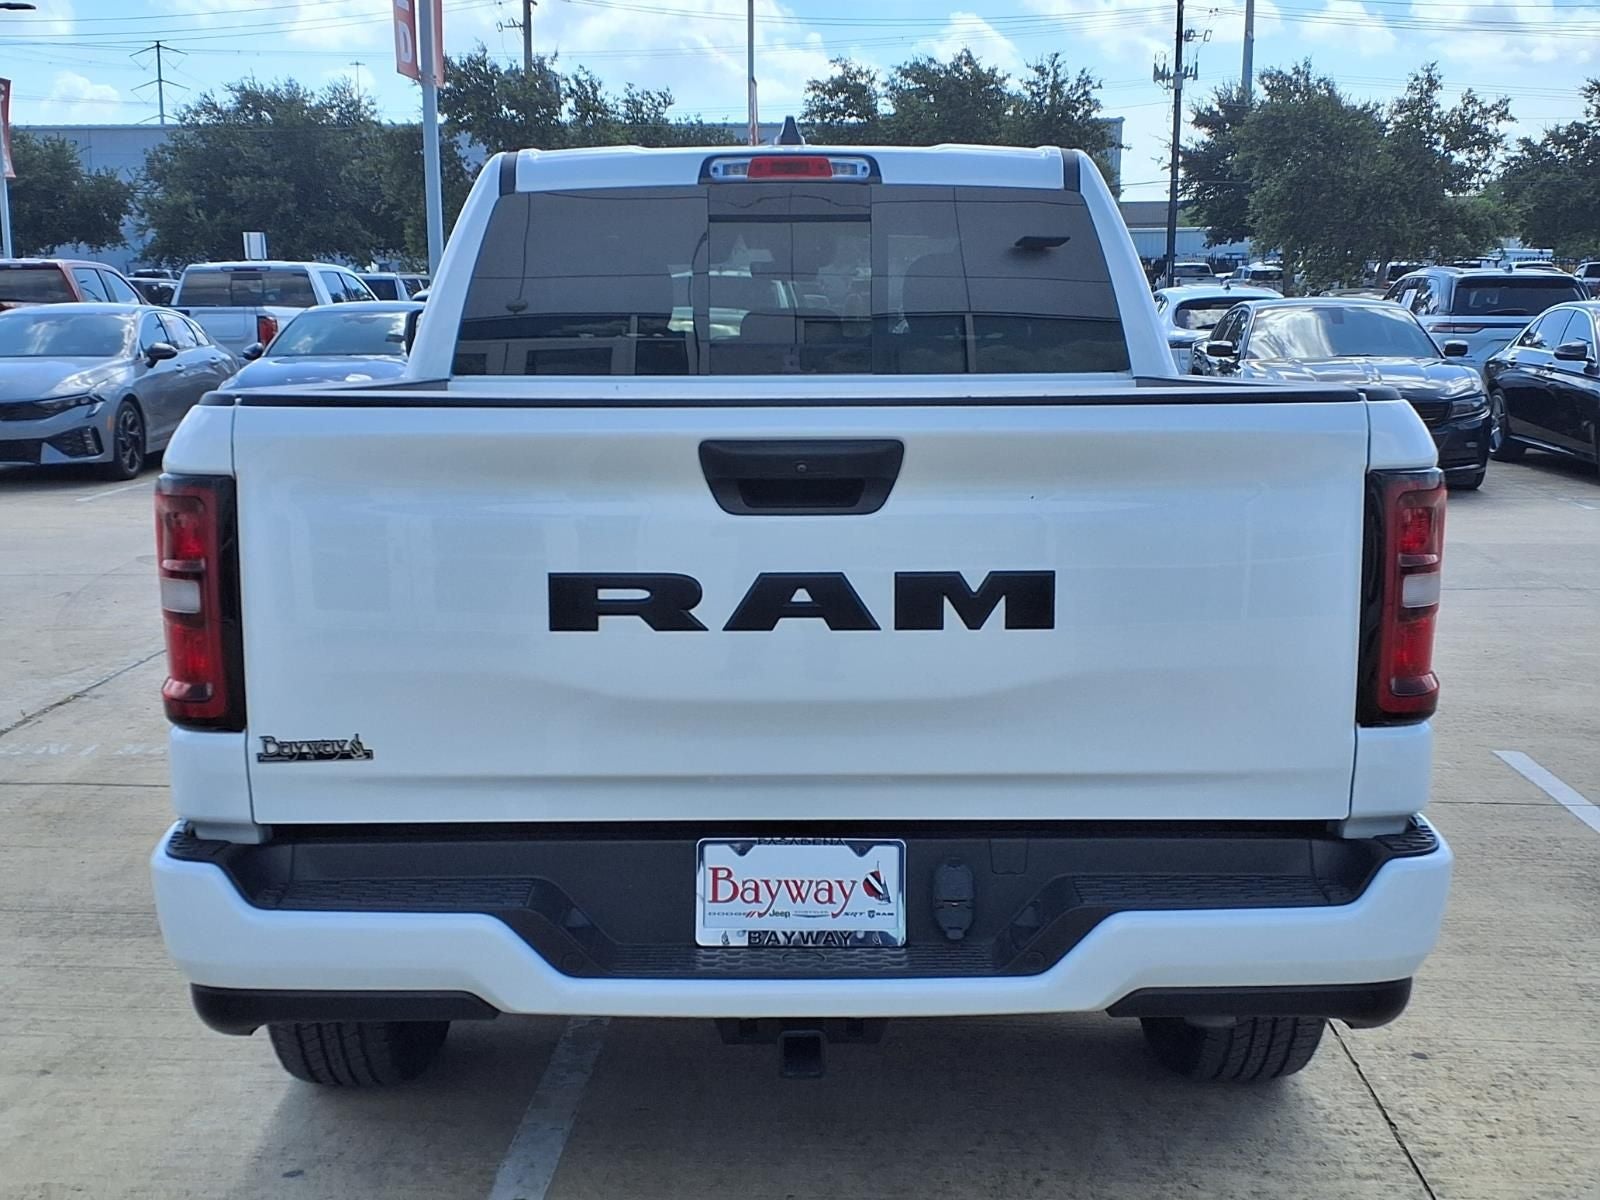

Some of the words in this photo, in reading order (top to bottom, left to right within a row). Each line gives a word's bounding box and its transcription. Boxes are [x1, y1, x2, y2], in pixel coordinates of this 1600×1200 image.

[548, 571, 1055, 632] RAM
[258, 735, 348, 761] Bayway
[708, 866, 859, 919] Bayway
[769, 910, 790, 919] Jeep
[749, 930, 852, 945] BAYWAY
